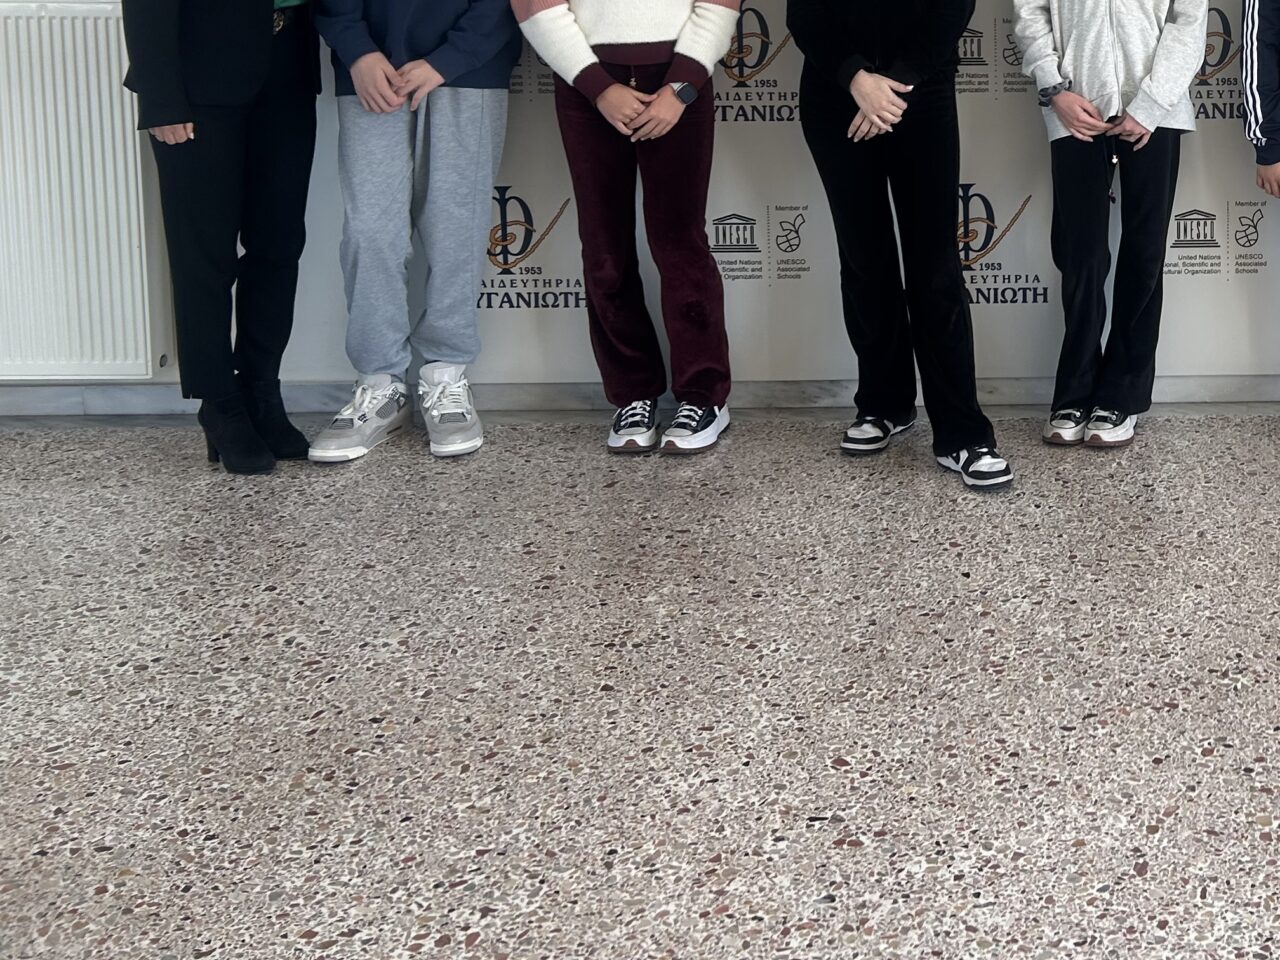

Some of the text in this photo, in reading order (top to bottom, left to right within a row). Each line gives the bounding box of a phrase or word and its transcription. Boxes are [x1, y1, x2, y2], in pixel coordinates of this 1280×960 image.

[754, 80, 778, 88] 1953
[714, 92, 798, 101] ΑΙΔΕΥΤΗΡ
[715, 225, 755, 245] UNESCO
[1177, 221, 1214, 240] UNESCO
[979, 263, 1002, 271] 1953
[481, 279, 582, 288] ΑΙΔΕΥΤΗΡΙΑ
[970, 275, 1040, 284] ΕΥΤΗΡΙΑ
